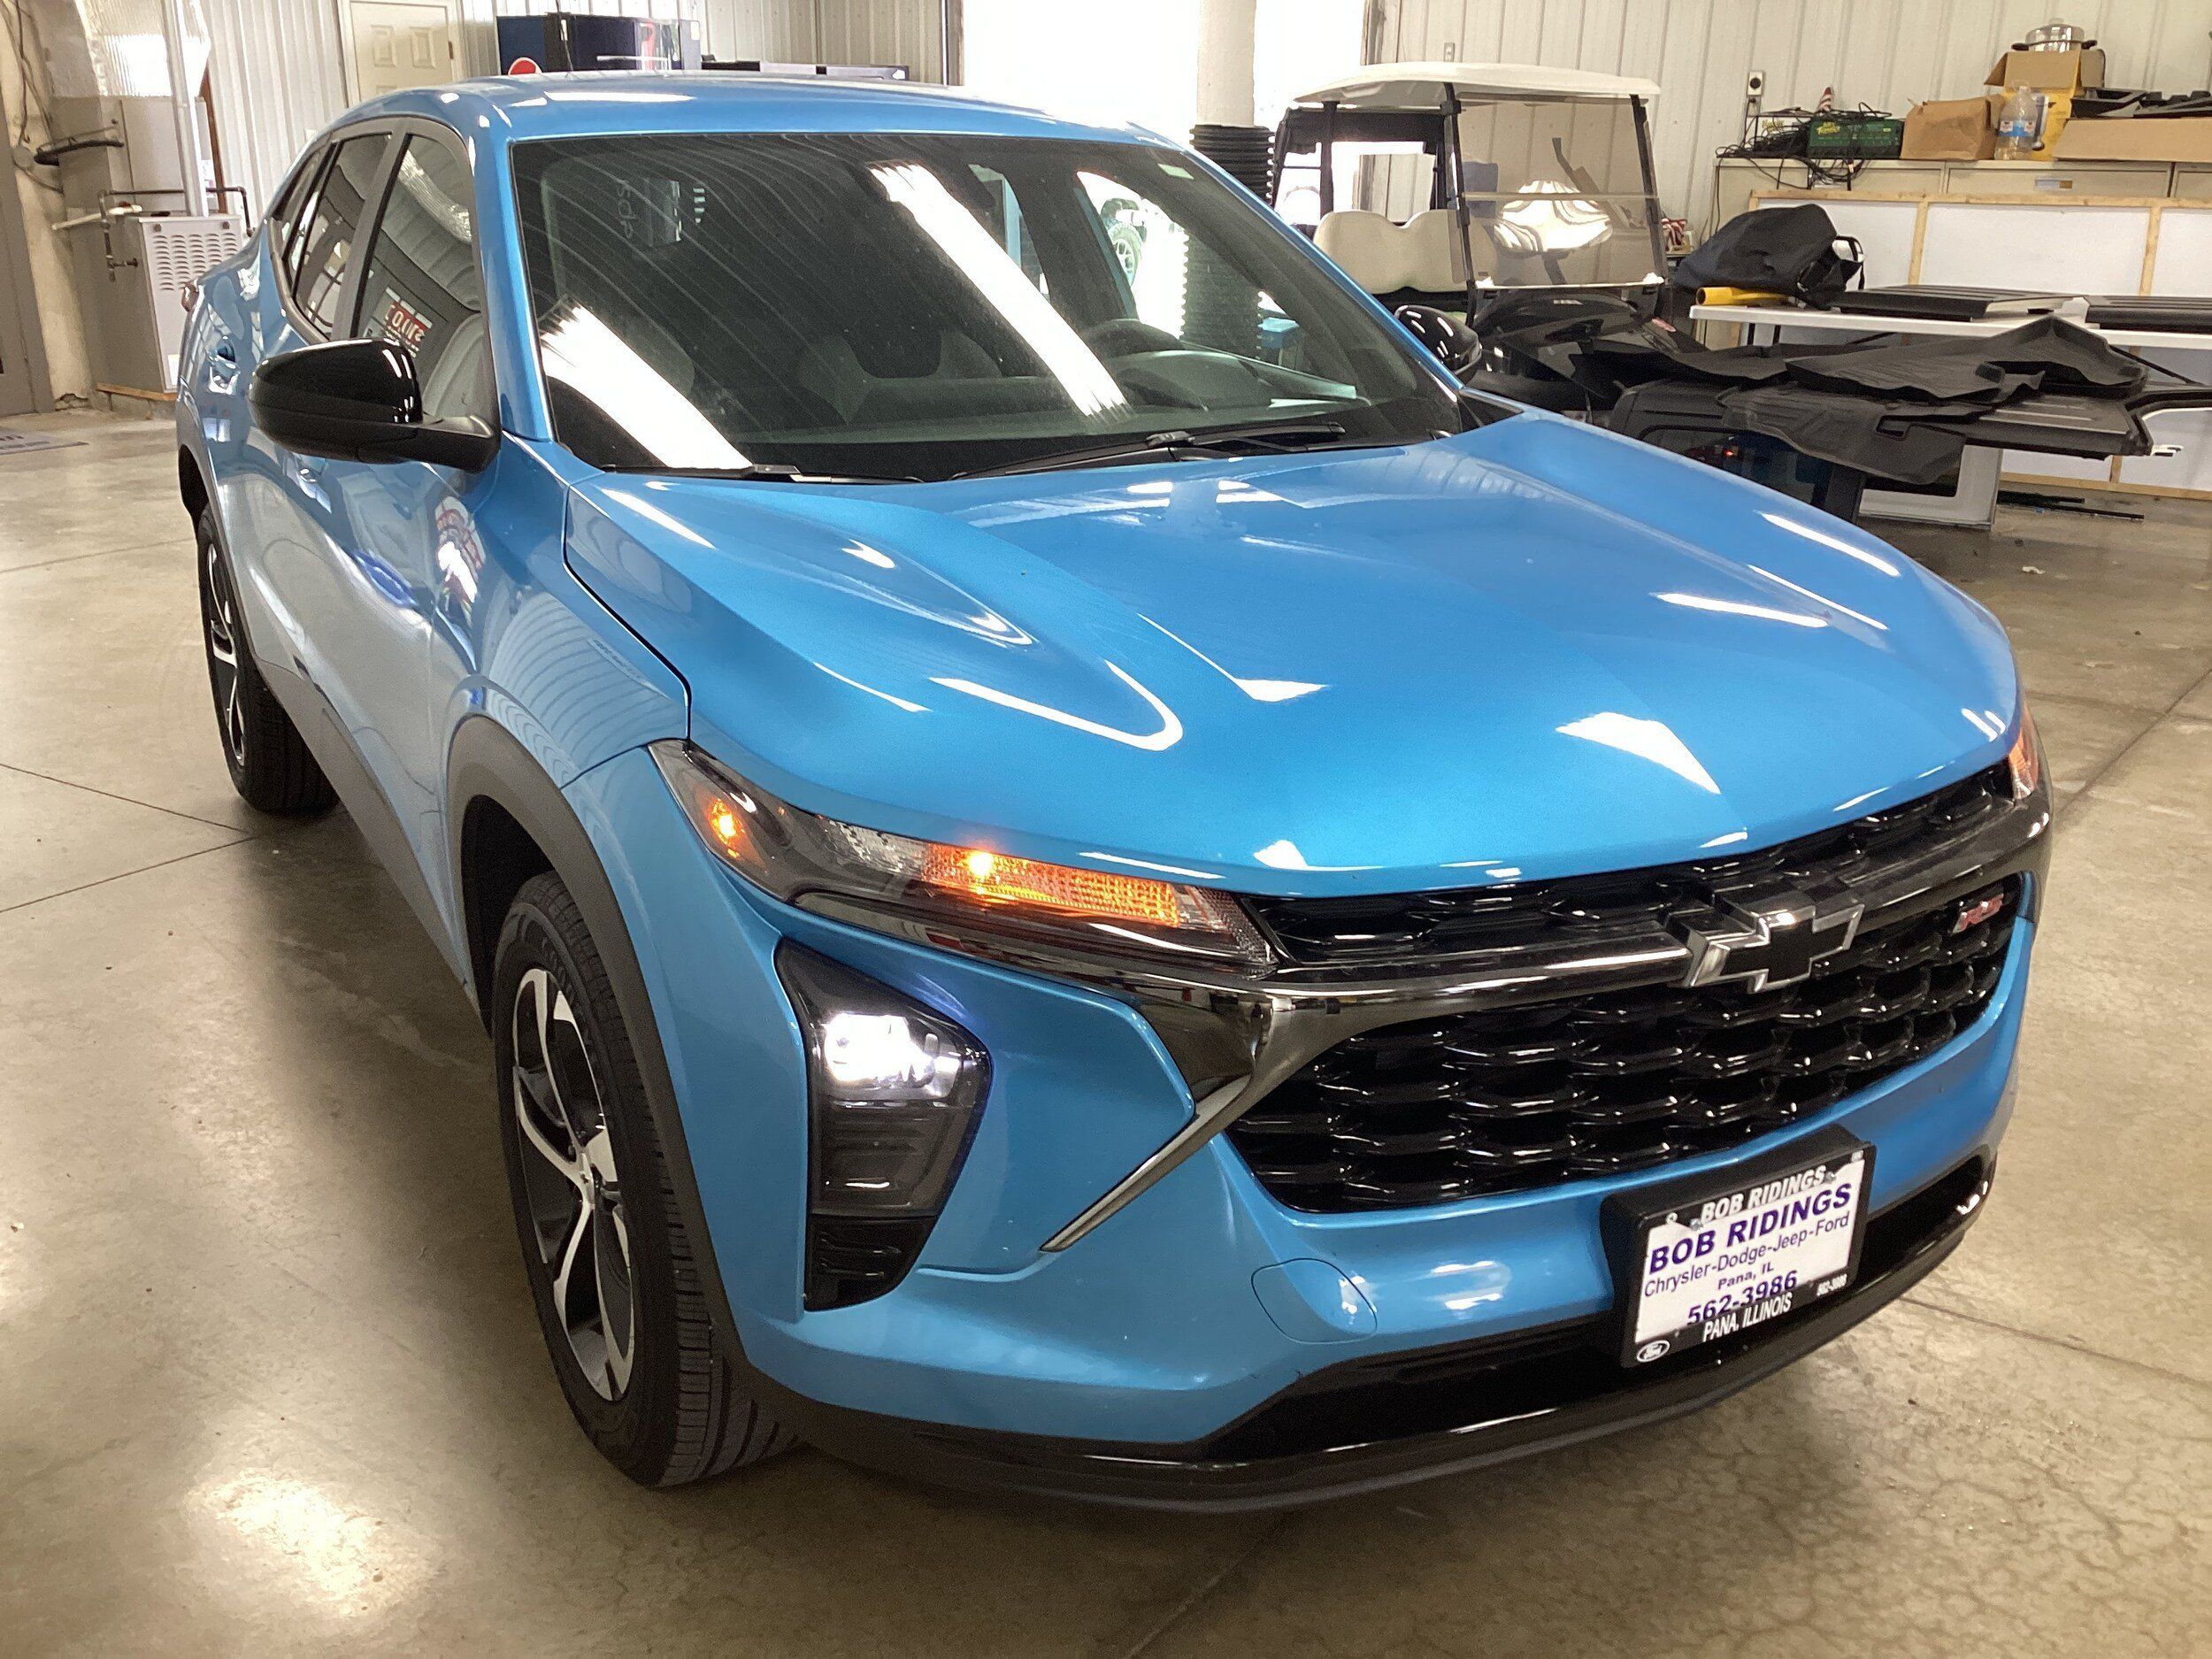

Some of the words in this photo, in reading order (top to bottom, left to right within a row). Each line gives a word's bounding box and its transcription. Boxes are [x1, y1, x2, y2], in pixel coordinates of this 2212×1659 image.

[1701, 1193, 1745, 1225] BOB
[1747, 1164, 1827, 1210] RIDINGS
[1644, 1210, 1850, 1297] Chrysler-Dodge-Jeep-Ford
[1648, 1229, 1717, 1275] BOB
[1726, 1182, 1852, 1248] RIDINGS
[1686, 1269, 1798, 1325] 562-3986
[1717, 1271, 1756, 1290] Pana,
[1761, 1261, 1774, 1275] IL
[1742, 1291, 1793, 1328] ILLINOIS
